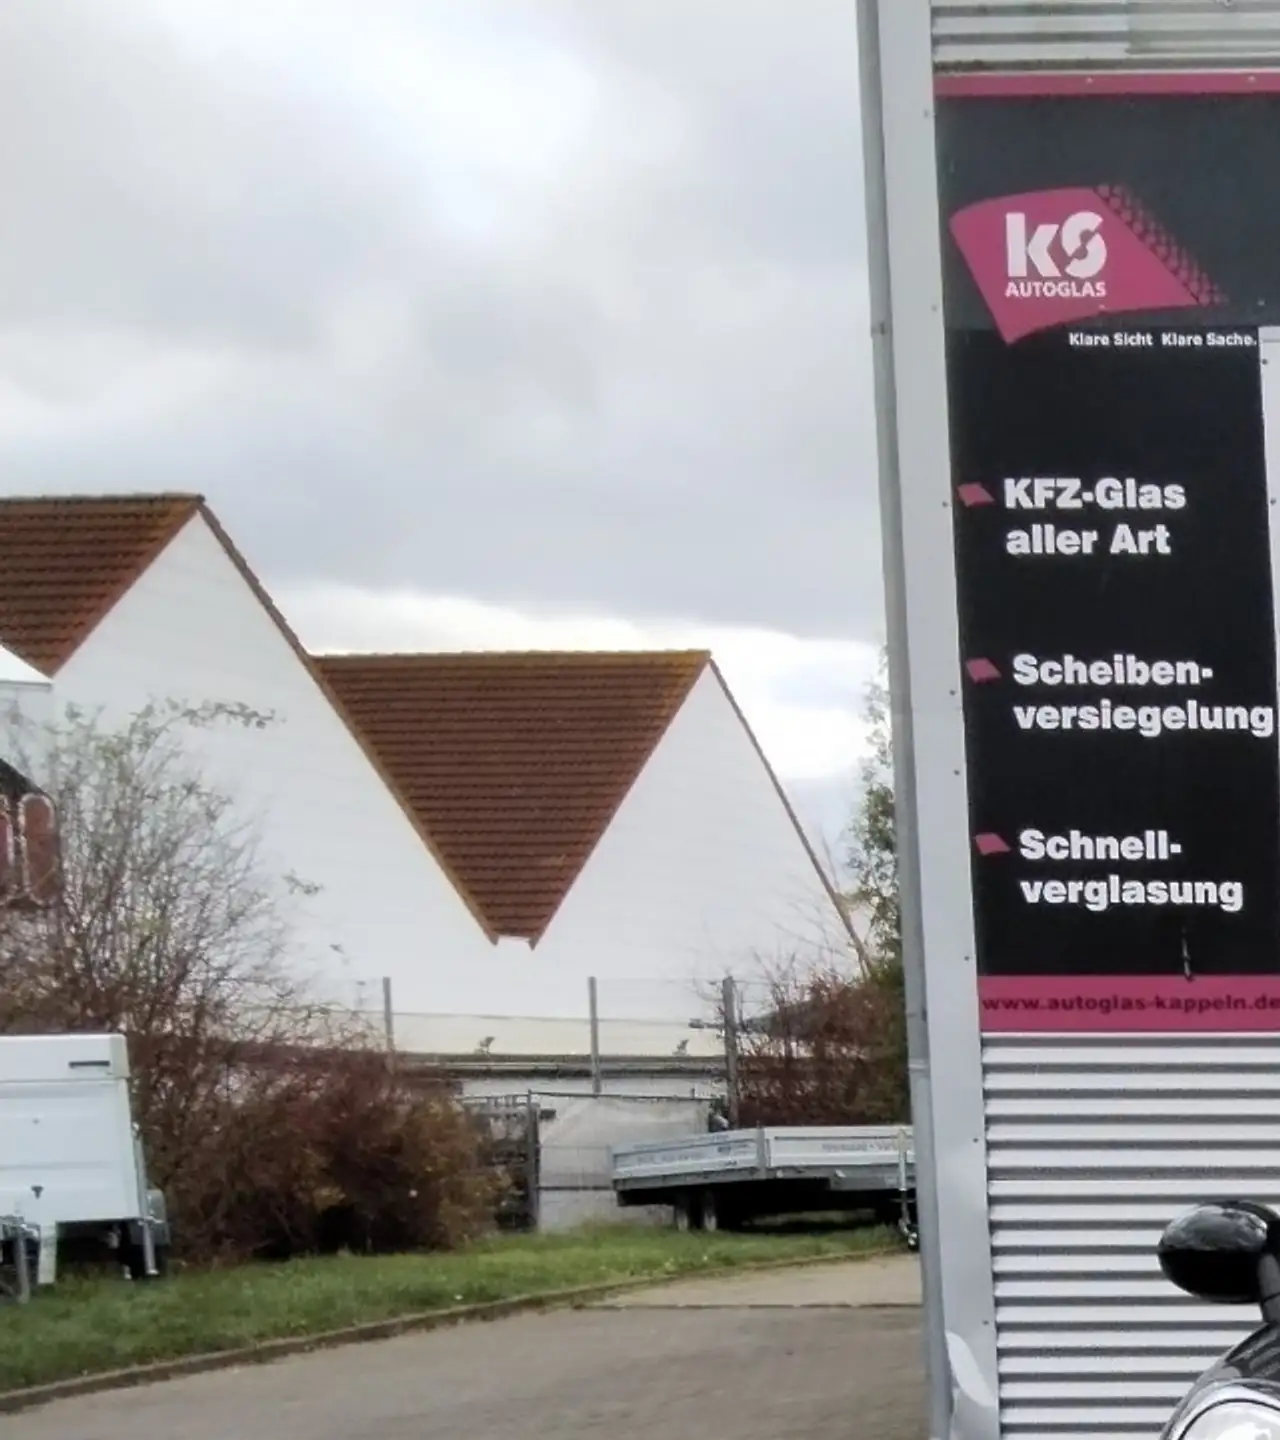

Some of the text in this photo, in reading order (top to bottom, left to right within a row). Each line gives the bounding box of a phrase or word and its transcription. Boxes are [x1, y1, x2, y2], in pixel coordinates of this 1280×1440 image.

[1005, 282, 1107, 298] AUTOGLAS
[1068, 332, 1109, 346] Klare
[1161, 332, 1203, 346] Klare
[1206, 332, 1257, 346] Sache.
[1004, 478, 1186, 509] KFZ-Glas
[1006, 523, 1171, 555] aller Art
[1012, 654, 1213, 685] Scheiben-
[1013, 699, 1274, 737] versiegelung
[1019, 829, 1182, 860] Schnell-
[1020, 874, 1243, 911] verglasung
